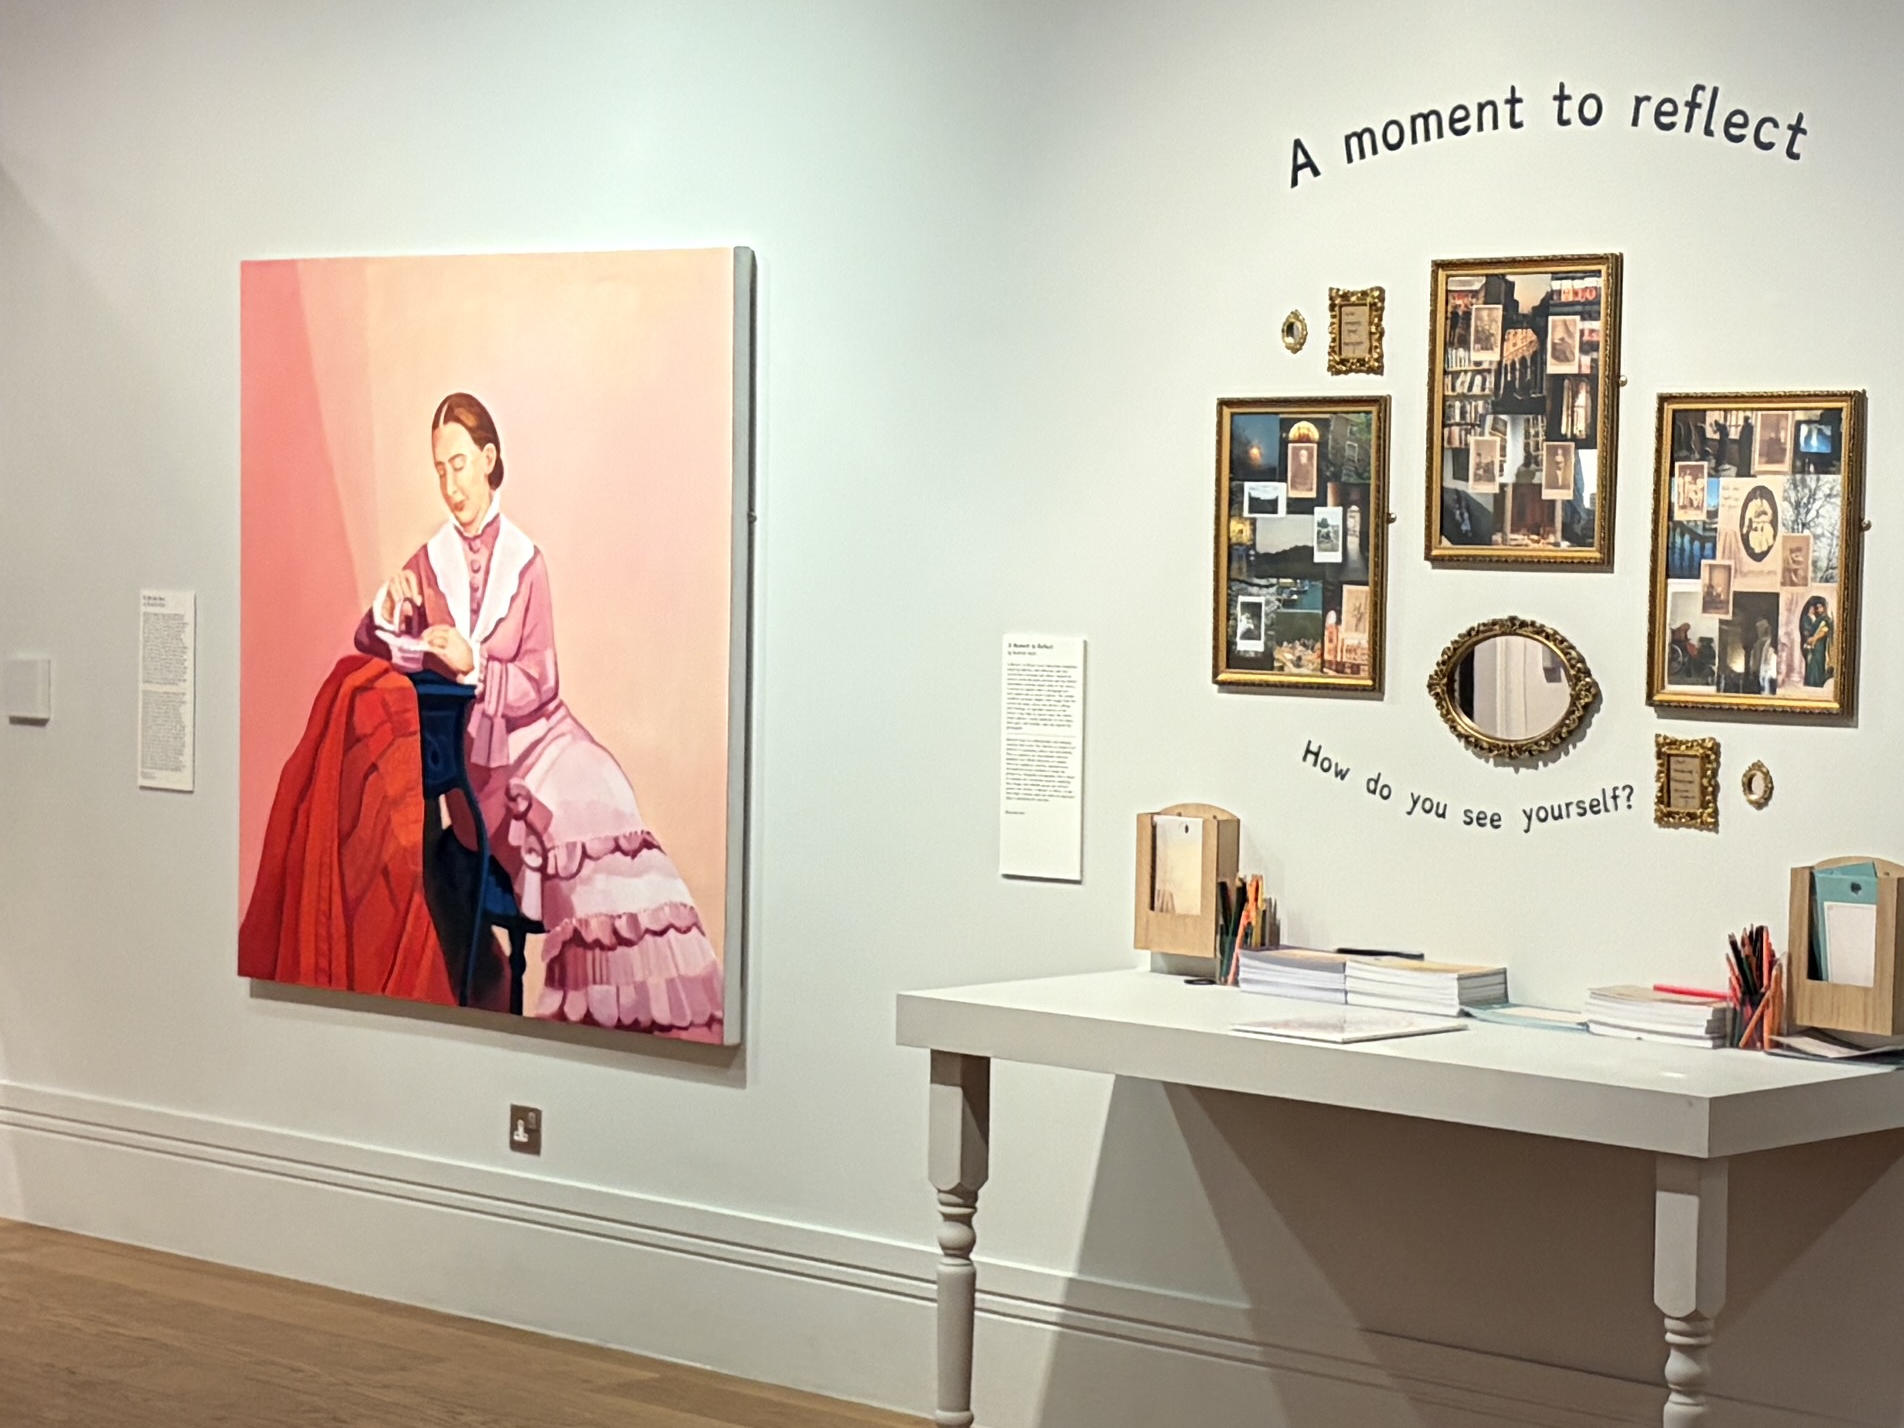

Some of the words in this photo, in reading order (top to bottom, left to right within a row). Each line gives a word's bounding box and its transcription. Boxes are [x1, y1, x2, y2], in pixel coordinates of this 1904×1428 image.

[1291, 138, 1321, 188] A
[1344, 85, 1524, 164] moment
[1552, 82, 1603, 126] to
[1631, 84, 1807, 160] reflect
[1302, 740, 1350, 780] How
[1366, 773, 1391, 800] do
[1406, 793, 1447, 819] you
[1463, 809, 1501, 829] see
[1522, 784, 1634, 833] yourself?
